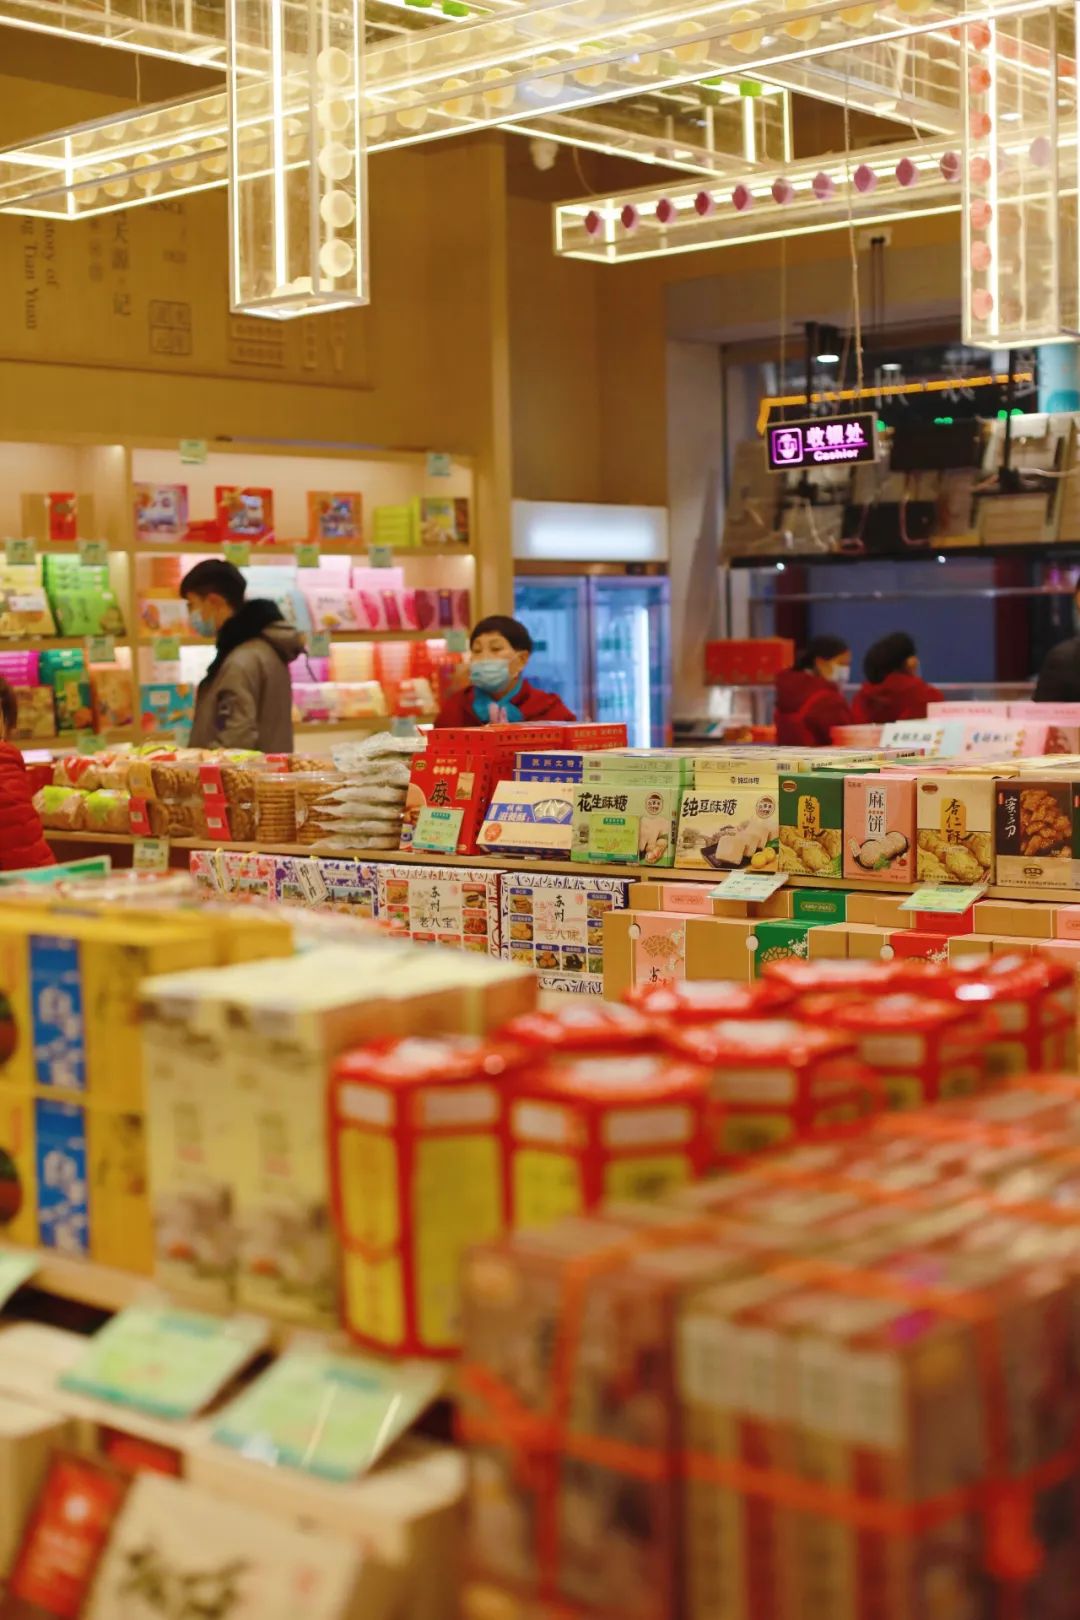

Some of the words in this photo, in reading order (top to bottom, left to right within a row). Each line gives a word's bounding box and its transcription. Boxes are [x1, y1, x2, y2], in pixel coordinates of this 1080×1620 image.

[807, 422, 864, 448] 收银处
[813, 448, 858, 461] Cashier
[577, 792, 628, 812] 花生酥糖
[682, 797, 738, 818] 纯豆酥糖
[868, 791, 884, 833] 麻饼
[430, 886, 440, 912] 苏州
[554, 895, 565, 922] 苏州
